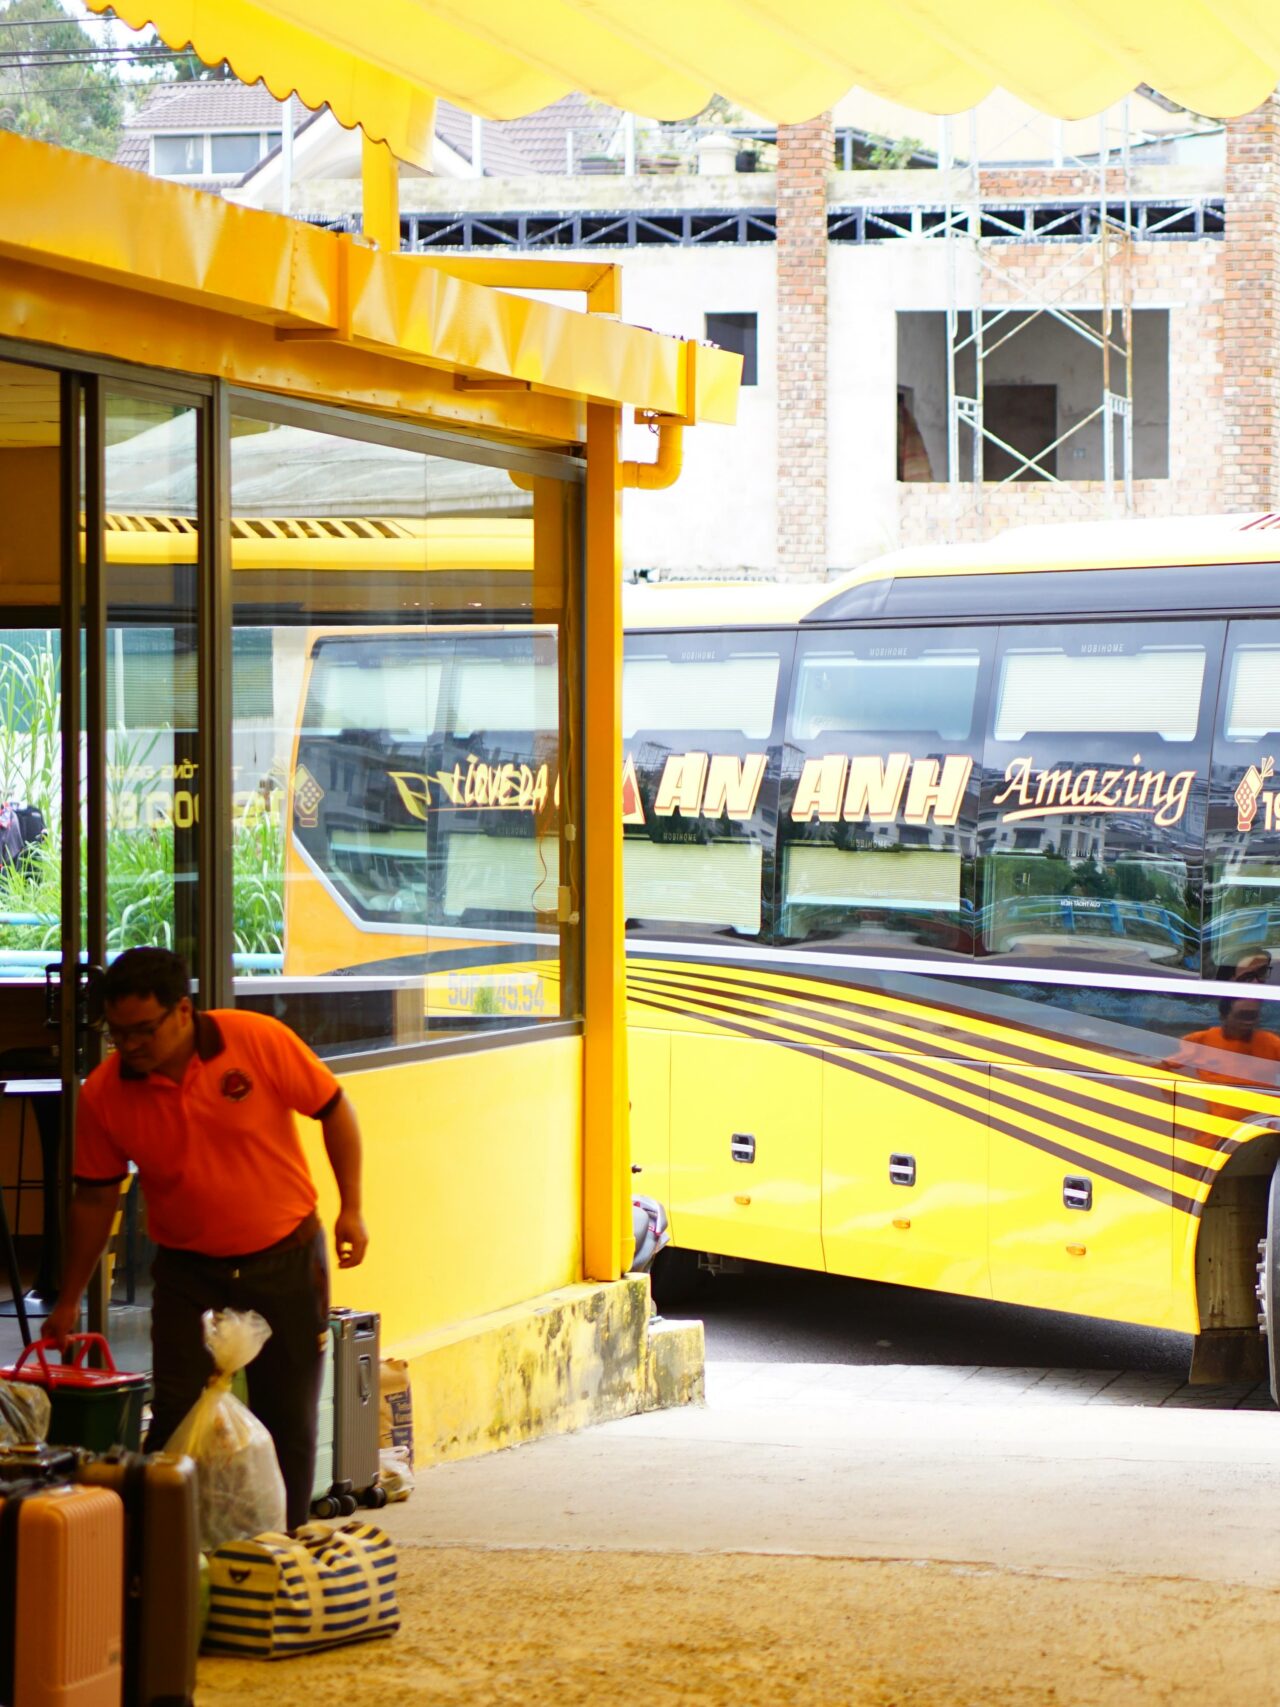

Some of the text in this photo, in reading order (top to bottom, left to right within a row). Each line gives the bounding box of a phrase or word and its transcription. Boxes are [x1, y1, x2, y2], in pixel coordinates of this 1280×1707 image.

[1080, 643, 1125, 653] MOBIHOME
[654, 752, 974, 825] AN ANH
[993, 753, 1198, 827] Amazing
